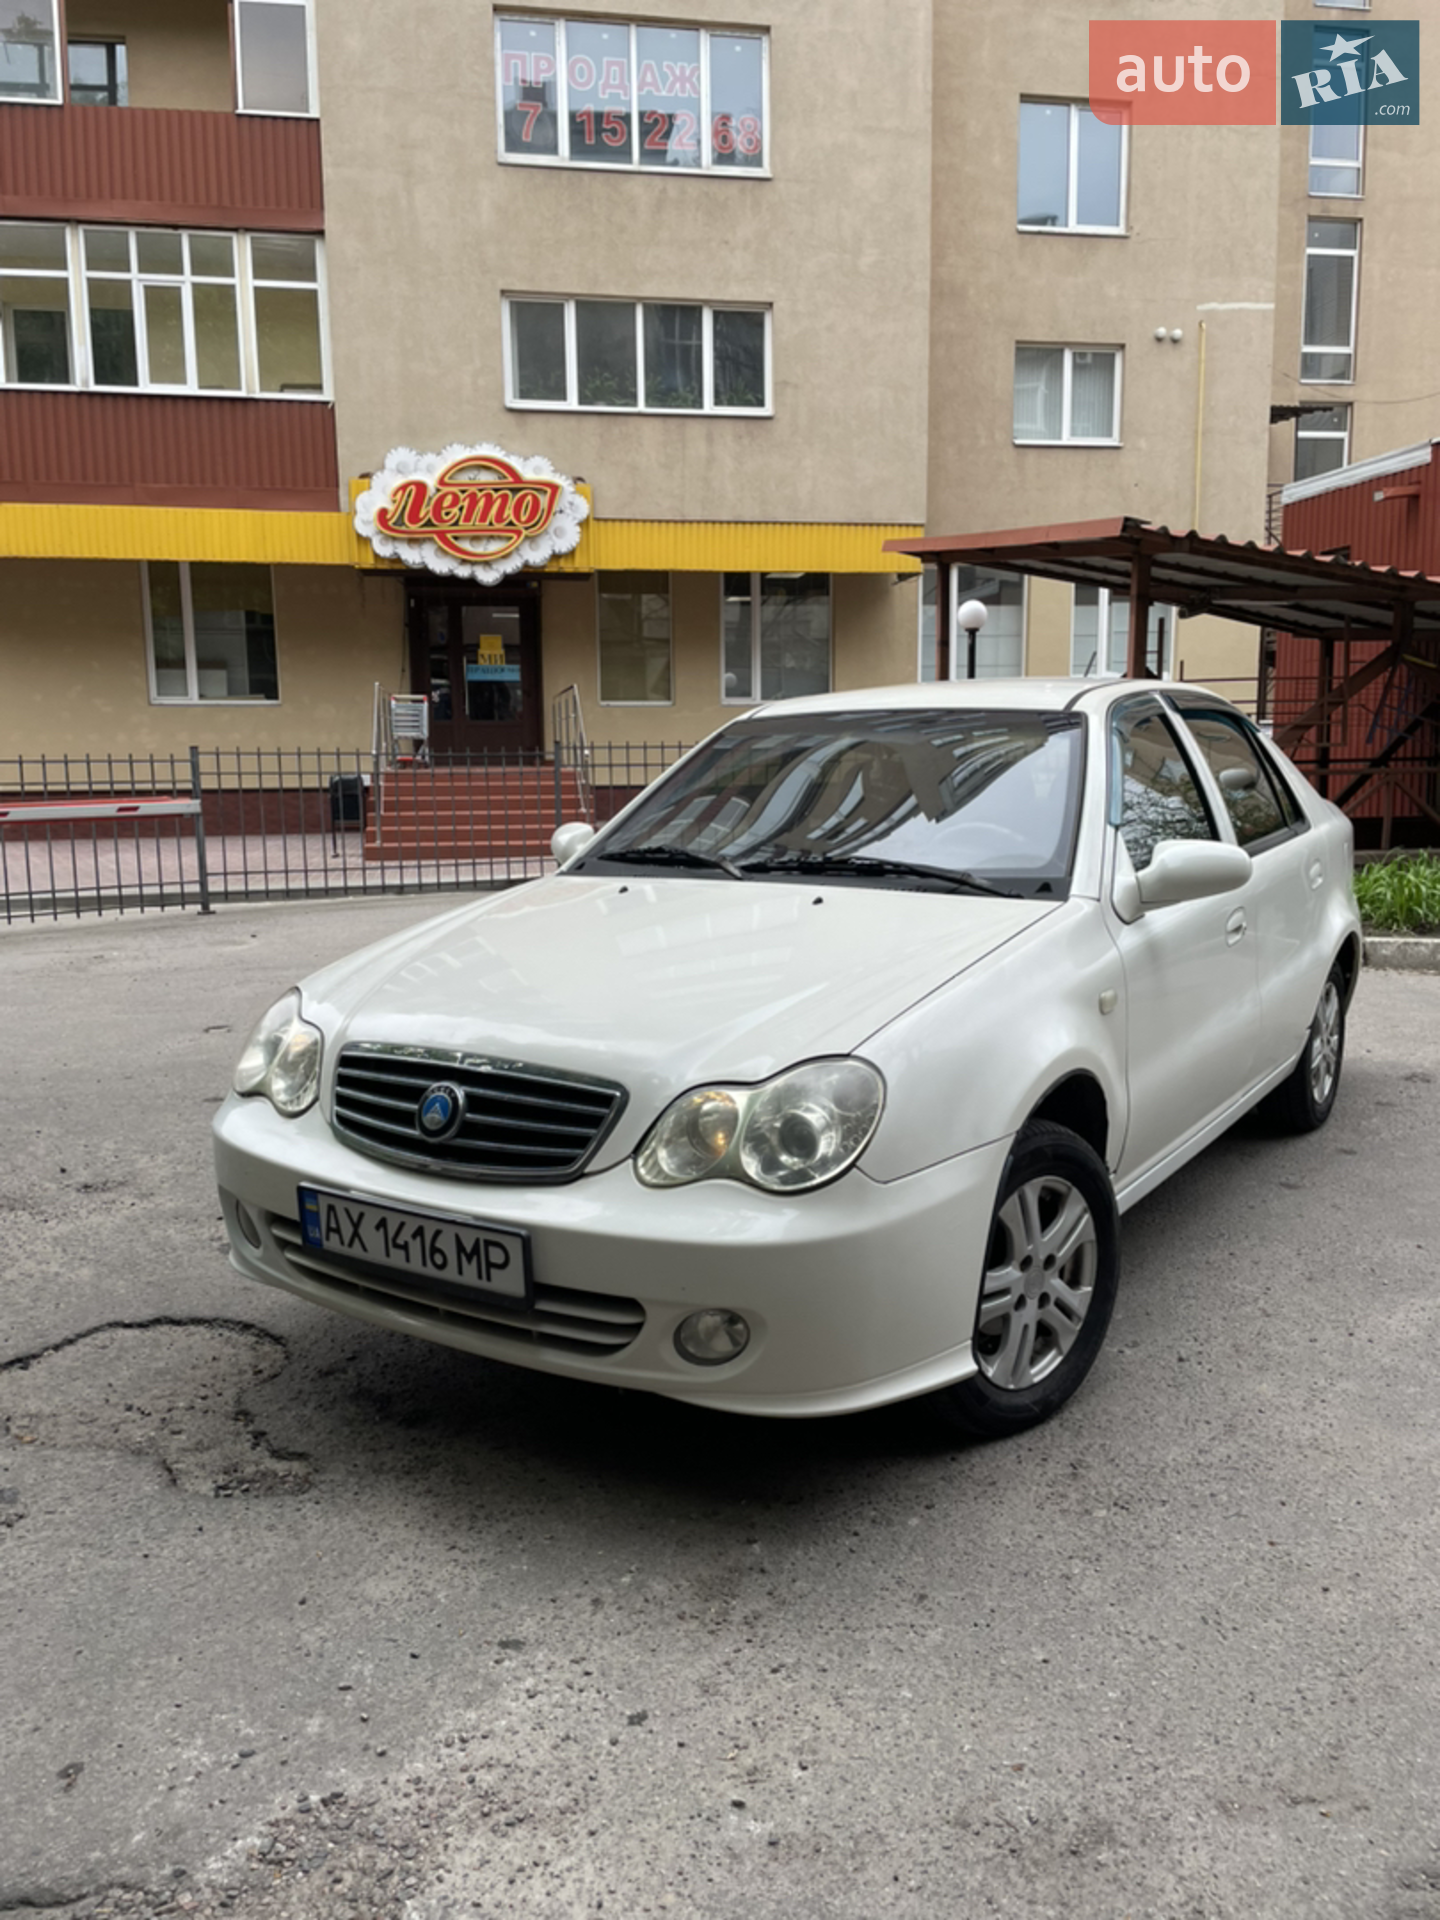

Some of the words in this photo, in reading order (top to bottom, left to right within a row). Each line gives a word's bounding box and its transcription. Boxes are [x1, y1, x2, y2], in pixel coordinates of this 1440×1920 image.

[502, 50, 701, 98] ПРОДАЖ
[378, 479, 560, 536] Лето
[325, 1203, 368, 1253] AX
[374, 1216, 448, 1271] 1416
[455, 1232, 510, 1282] MP
